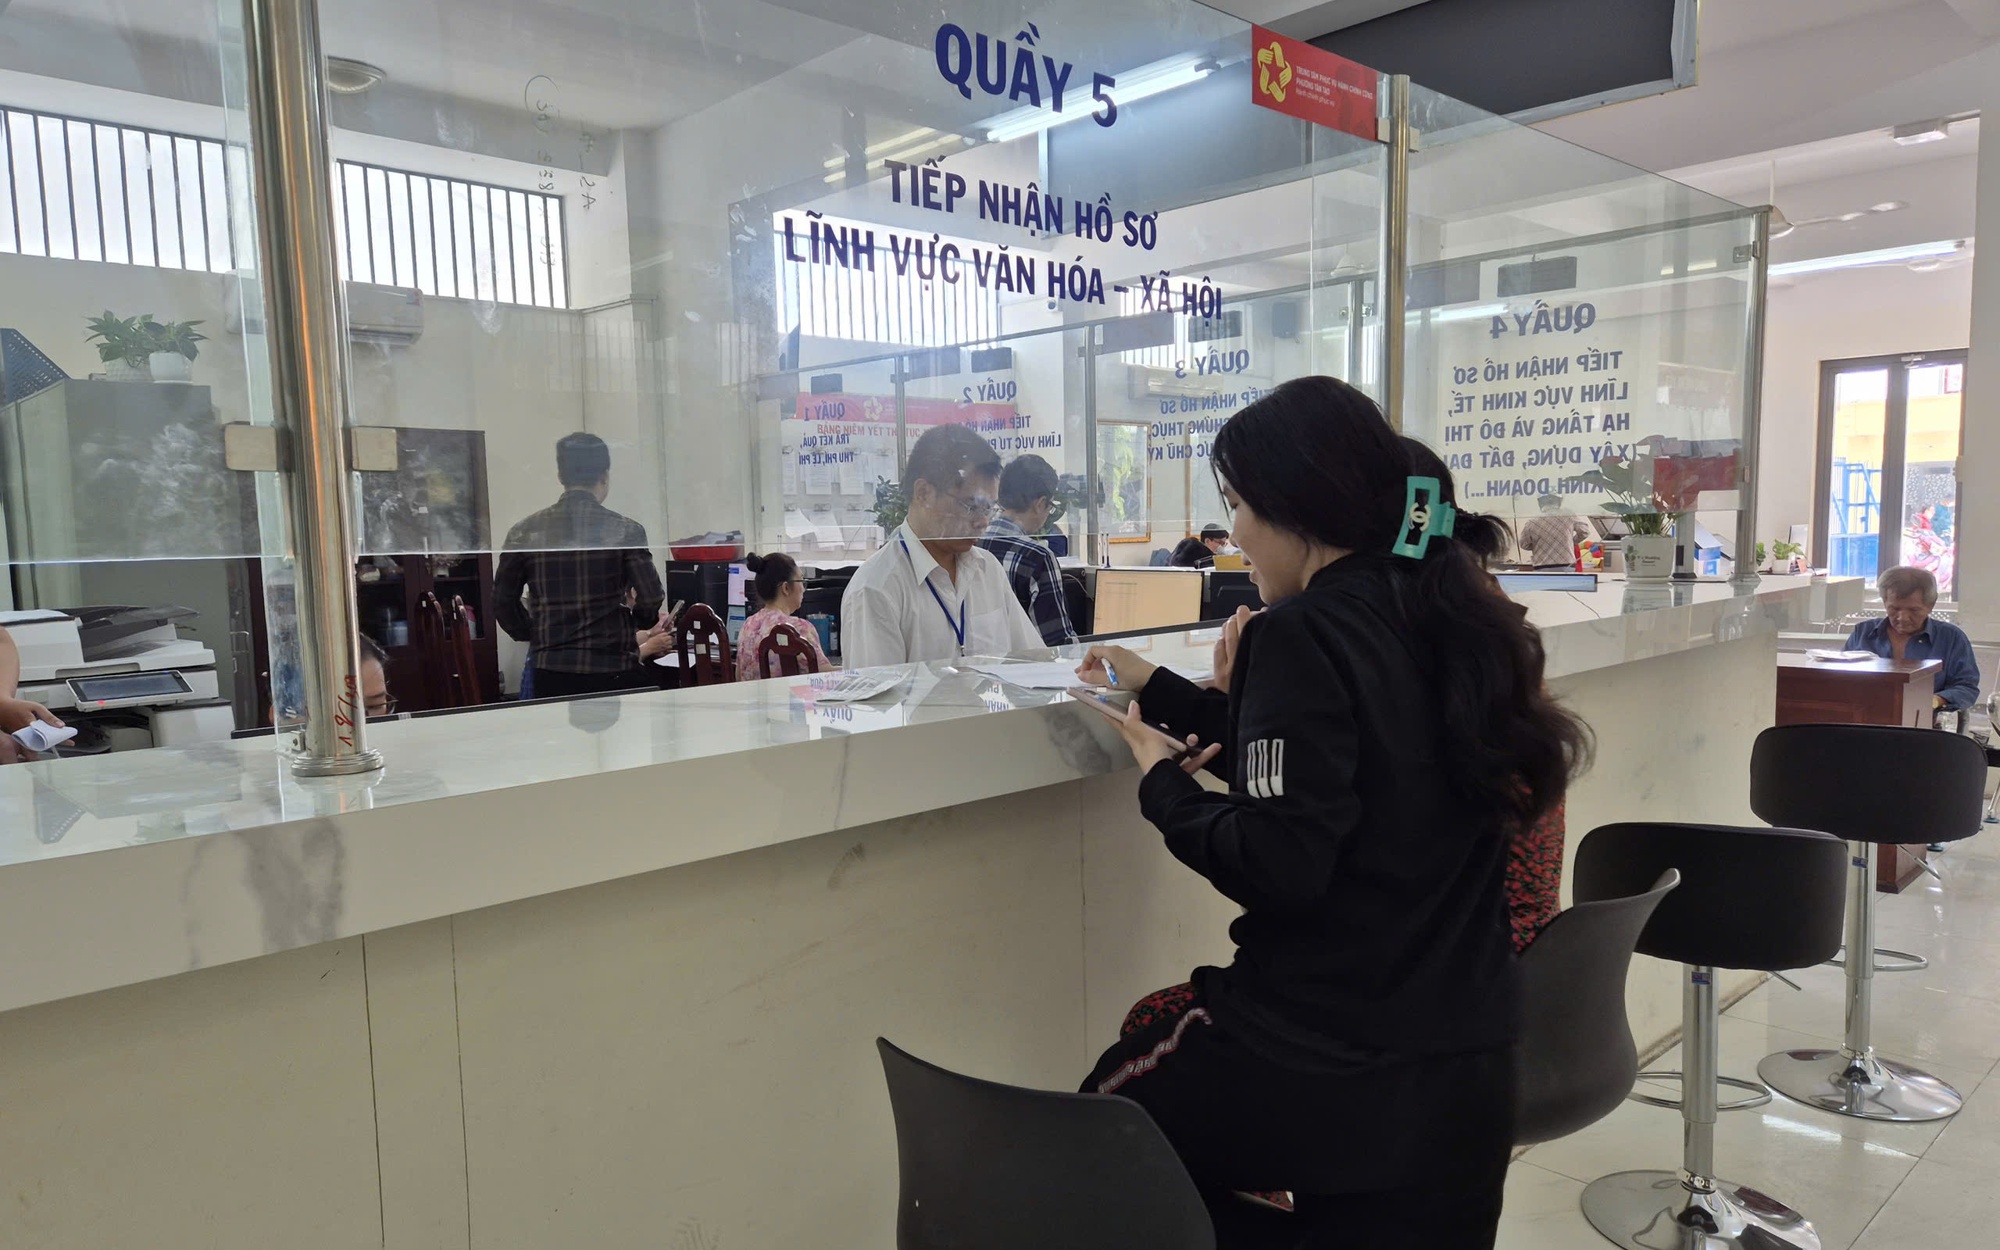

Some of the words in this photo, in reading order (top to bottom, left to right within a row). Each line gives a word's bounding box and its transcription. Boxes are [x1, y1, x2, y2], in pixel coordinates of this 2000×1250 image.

[935, 22, 1072, 113] QUẦY
[1092, 76, 1117, 127] 5
[884, 155, 965, 213] TIẾP
[979, 182, 1063, 238] NHẬN
[1075, 192, 1112, 244] HỒ
[1123, 210, 1158, 250] SƠ
[784, 212, 875, 273] LĨNH
[889, 233, 961, 290] VỰC
[972, 244, 1036, 296] VĂN
[1048, 255, 1105, 305] HÓA
[1141, 269, 1172, 314] XÃ
[1182, 276, 1222, 320] HỘI
